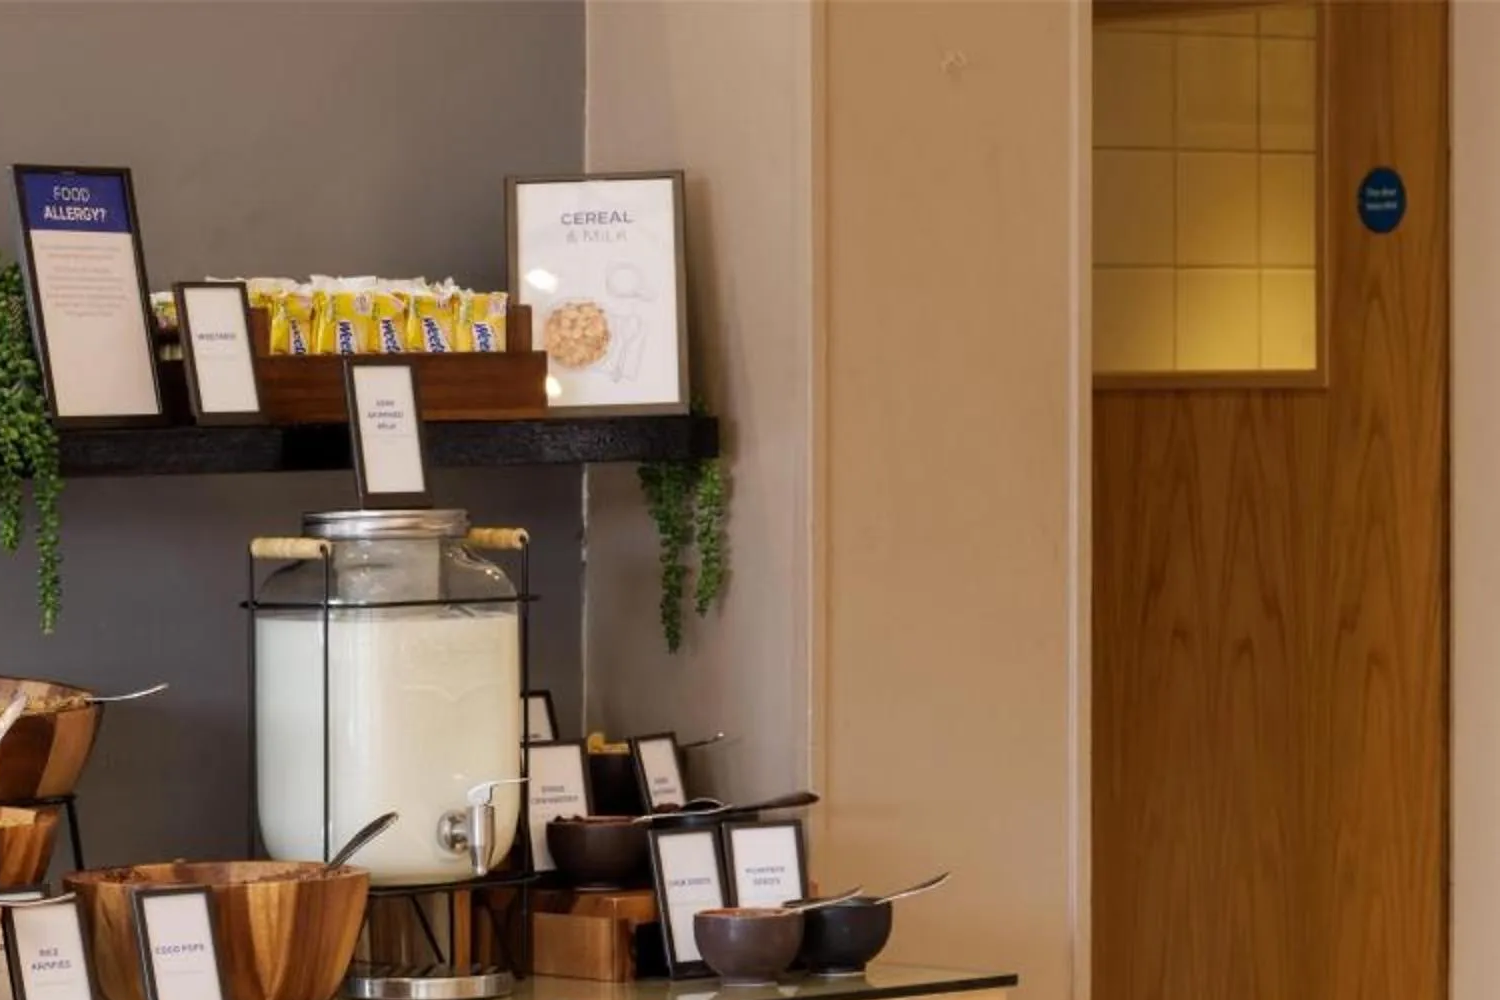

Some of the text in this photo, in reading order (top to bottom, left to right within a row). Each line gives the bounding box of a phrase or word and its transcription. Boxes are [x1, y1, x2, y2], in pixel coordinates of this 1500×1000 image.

[53, 186, 90, 202] FOOD
[43, 205, 107, 222] ALLERGY?
[560, 210, 636, 225] CEREAL
